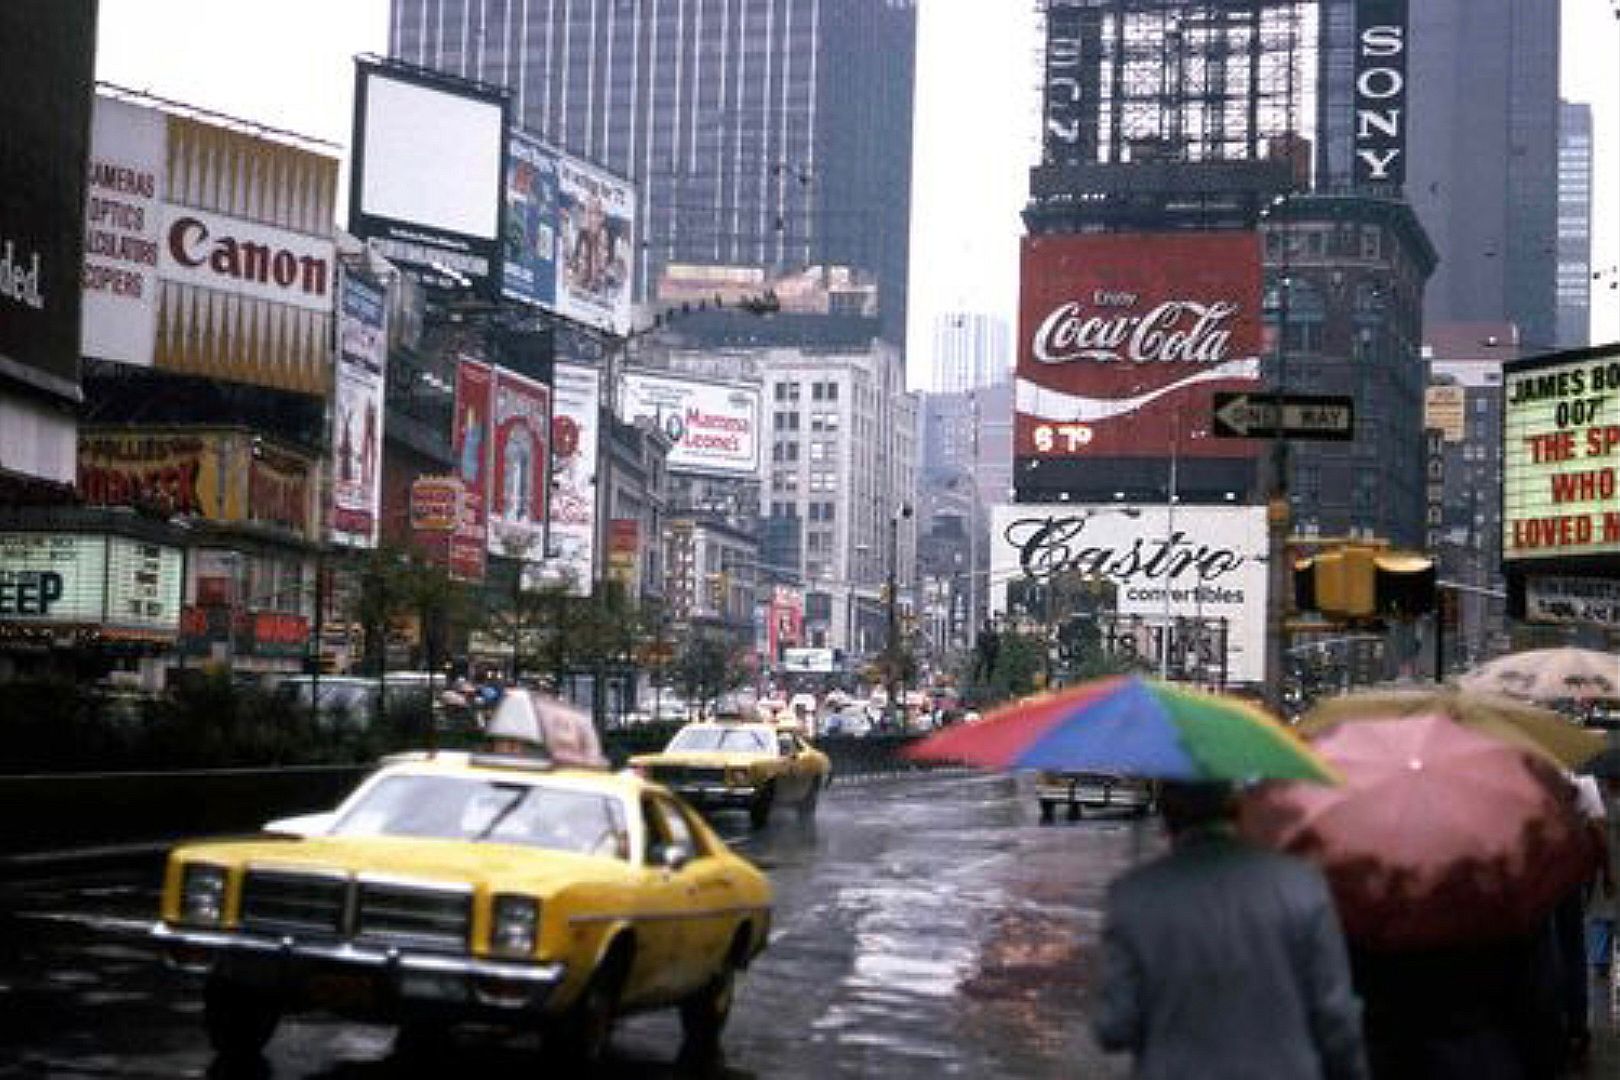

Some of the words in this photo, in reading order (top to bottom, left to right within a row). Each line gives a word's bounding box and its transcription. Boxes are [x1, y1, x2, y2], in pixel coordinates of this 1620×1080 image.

[1356, 26, 1402, 178] SONY
[168, 217, 327, 295] Canon
[1094, 290, 1139, 308] Enjoy
[1033, 301, 1240, 363] Coca-Cola
[1508, 369, 1585, 406] JAMES
[684, 406, 748, 434] Mamma
[1231, 404, 1276, 428] ONE
[1300, 405, 1343, 429] WAY
[1556, 396, 1606, 430] 007
[680, 430, 741, 453] Leone's
[1525, 430, 1576, 465] THE
[1551, 467, 1614, 504] WHO
[1004, 512, 1246, 583] Castro
[1513, 513, 1592, 549] LOVED
